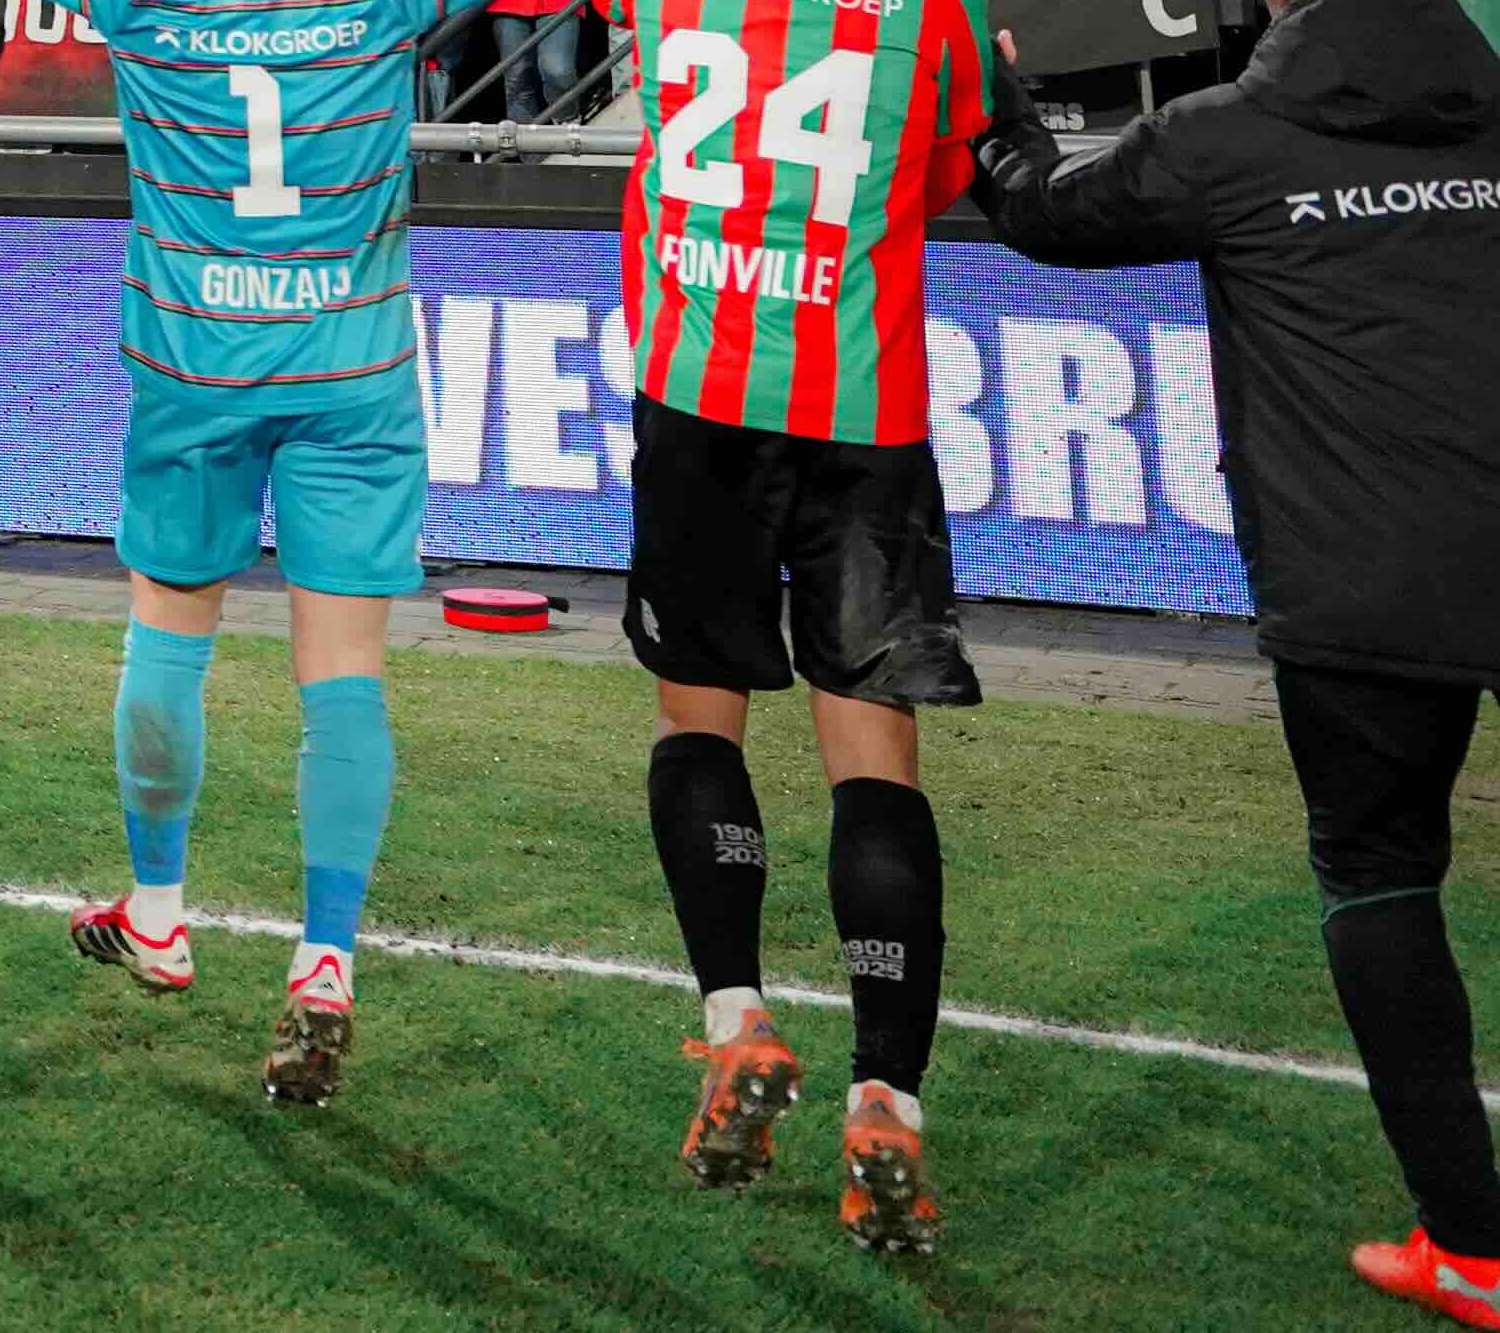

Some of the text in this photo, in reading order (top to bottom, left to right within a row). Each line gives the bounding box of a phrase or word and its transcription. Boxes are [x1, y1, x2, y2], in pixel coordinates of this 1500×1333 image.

[189, 19, 368, 57] KLOKGROEP
[228, 64, 302, 218] 1
[656, 29, 875, 228] 24
[659, 231, 843, 306] FONVILLE
[709, 821, 762, 845] 190
